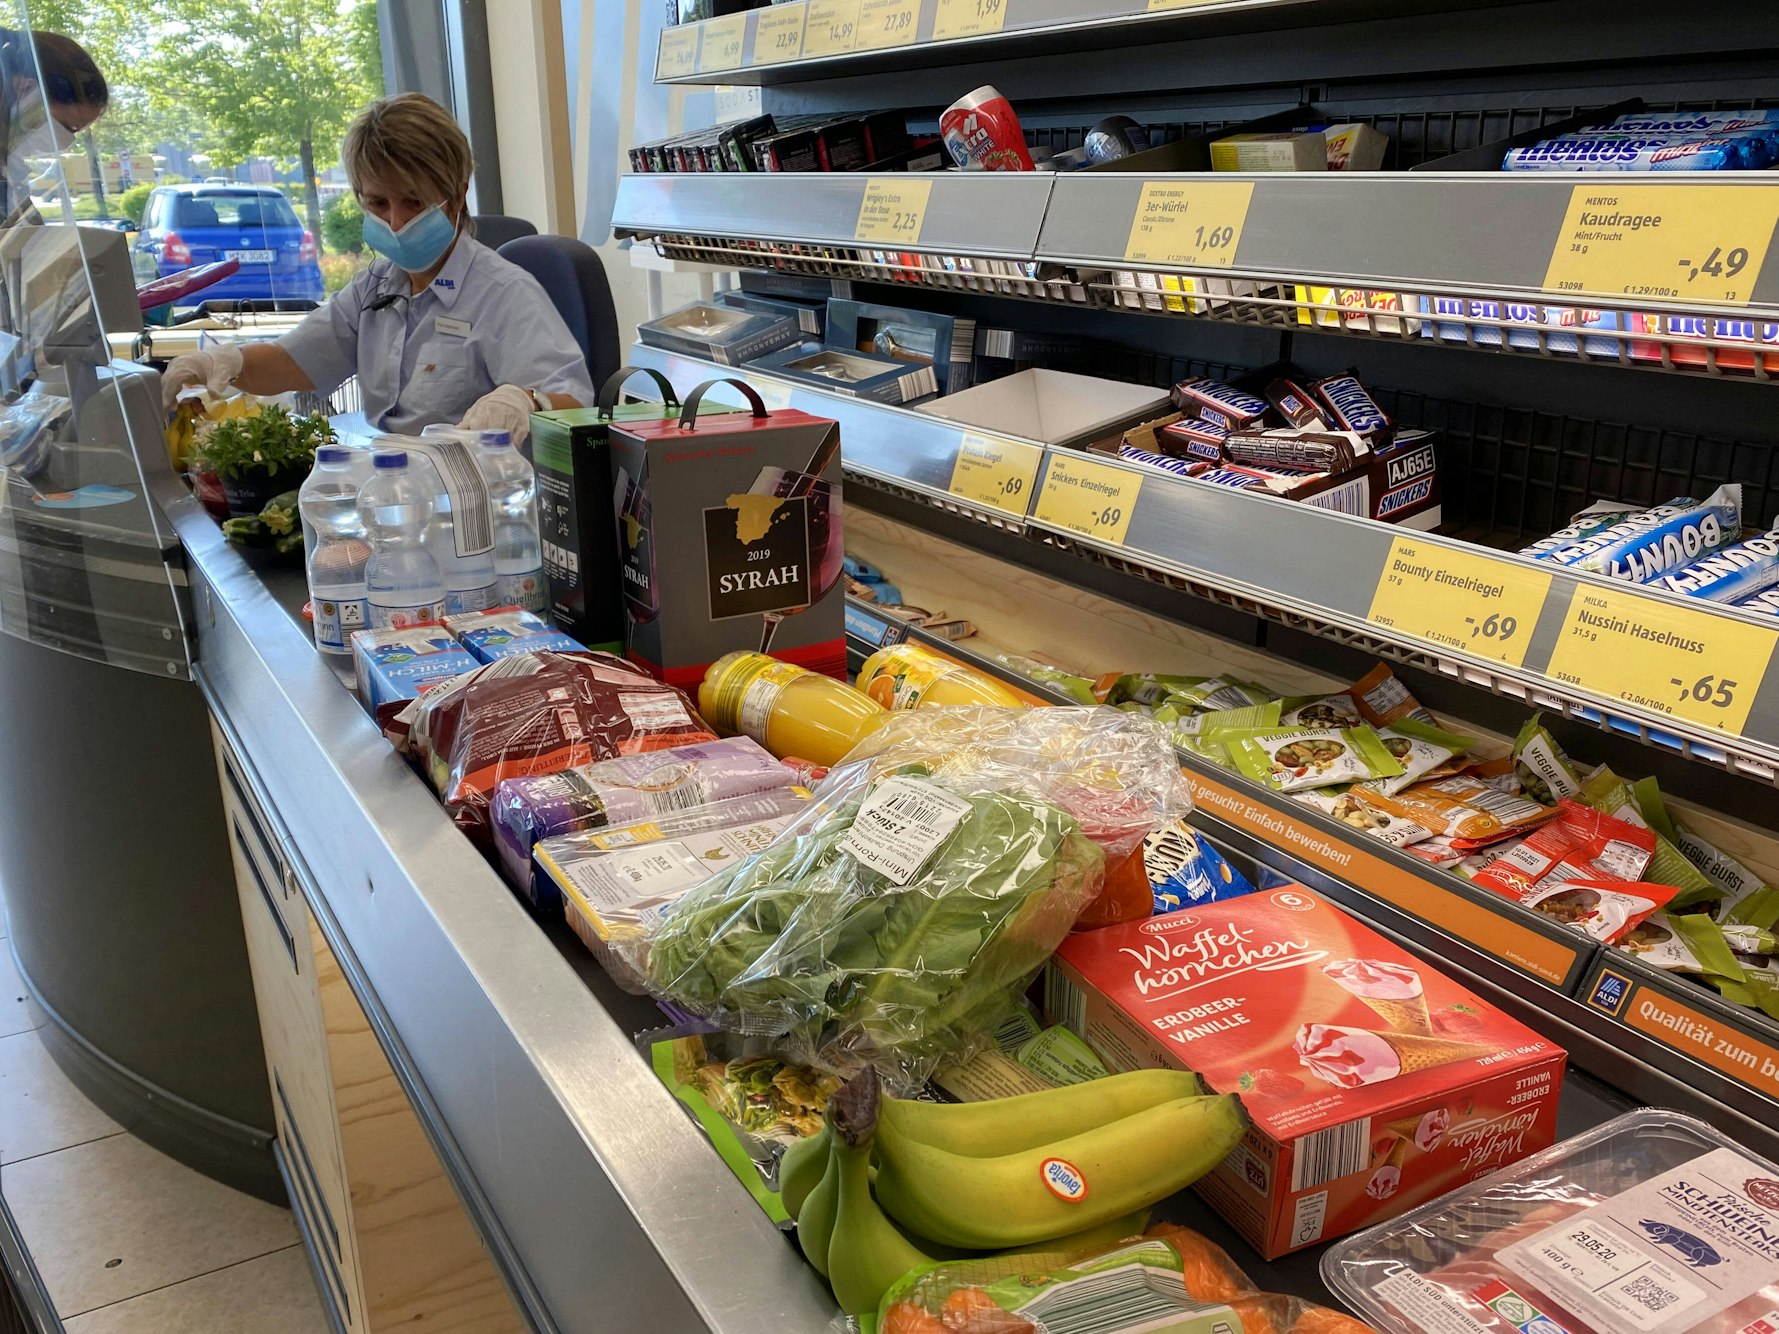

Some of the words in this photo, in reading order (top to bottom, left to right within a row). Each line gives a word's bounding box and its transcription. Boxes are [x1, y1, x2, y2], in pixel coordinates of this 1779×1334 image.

[884, 12, 912, 31] 27,89
[776, 32, 798, 49] 22,99
[830, 24, 852, 40] 14,99
[724, 42, 739, 58] 6,99
[972, 140, 996, 162] WHITE
[1514, 146, 1643, 164] mentos
[888, 194, 901, 203] Extra
[1145, 201, 1189, 212] 3er-Würfel
[1585, 197, 1618, 206] MENTOS
[869, 205, 878, 214] der
[892, 212, 917, 232] 2,25
[1579, 212, 1662, 230] Kaudragee
[1195, 225, 1234, 252] 1,69
[1574, 230, 1622, 242] Mint/Frucht
[1570, 243, 1581, 252] 38
[1582, 244, 1588, 254] g
[1678, 246, 1749, 282] -,49
[1557, 281, 1584, 290] 53098
[1623, 285, 1630, 294] €
[1724, 291, 1736, 300] 13
[1324, 377, 1388, 430] SNICKERS
[1201, 407, 1226, 427] SNICKERS
[983, 449, 1003, 463] Riegel
[1189, 441, 1220, 459] SNICKERS
[1392, 449, 1432, 483] AJ65E
[997, 478, 1022, 496] -,69
[1051, 470, 1078, 486] Snickers
[1080, 478, 1120, 497] Einzelriegel
[1379, 479, 1431, 516] SNICKERS
[1091, 506, 1121, 526] -,69
[747, 548, 771, 562] 2019
[1397, 547, 1416, 558] MARS
[1610, 512, 1720, 583] BOUNTY
[624, 564, 649, 590] SYRAH
[719, 564, 799, 595] SYRAH
[1392, 560, 1434, 582] Bounty
[1434, 570, 1504, 598] Einzelriegel
[1583, 596, 1608, 609] MILKA
[1374, 614, 1394, 627] 52952
[1464, 613, 1517, 641] -,69
[1431, 632, 1460, 647] 1,21/100
[1572, 627, 1591, 639] 31,5
[1590, 631, 1597, 642] g
[1578, 609, 1630, 634] Nussini
[1630, 623, 1705, 654] Haselnuss
[388, 658, 470, 678] H-MILCH
[1556, 671, 1581, 685] 53638
[1670, 674, 1738, 708] -,65
[1620, 691, 1627, 699] €
[1627, 692, 1665, 712] 2,06/100
[1717, 720, 1724, 729] 4
[1262, 731, 1297, 743] VEGGIE
[1530, 746, 1558, 781] VEGGIE
[864, 807, 897, 831] Stück
[1198, 784, 1245, 814] gesucht?
[1244, 806, 1284, 836] Einfach
[1285, 825, 1352, 866] bewerben!
[894, 824, 907, 836] 2
[915, 822, 940, 838] L2007
[842, 835, 909, 880] Mini-Roma
[1514, 847, 1540, 864] 10.01.2021
[1678, 837, 1713, 870] VEGGIE
[1710, 863, 1745, 892] BURST
[1279, 894, 1302, 905] 6
[1145, 916, 1194, 933] Mucci
[1118, 922, 1254, 970] Waffel-
[1133, 939, 1309, 995] hörnchen
[1505, 950, 1561, 981] karriere.aldi-sued.de
[1596, 990, 1618, 1006] ALDI
[1151, 996, 1247, 1030] ERDBEER-
[1168, 1012, 1251, 1044] VANILLE
[1640, 1000, 1715, 1047] Qualität
[1713, 1039, 1758, 1069] zum
[1476, 1057, 1494, 1066] 720
[1515, 1071, 1551, 1091] VANILLE
[1506, 1084, 1551, 1106] ERDBEER-
[1300, 1109, 1312, 1117] und
[1448, 1107, 1539, 1148] hörnchen
[1248, 1135, 1263, 1152] 120
[1460, 1130, 1524, 1170] Waffel-
[1049, 1163, 1081, 1195] favorita
[1249, 1171, 1265, 1187] UTZ
[1717, 1194, 1771, 1226] Frische
[1678, 1214, 1692, 1224] oder
[1704, 1229, 1716, 1238] den
[1718, 1237, 1732, 1248] Grill
[1712, 1224, 1727, 1234] dem
[1571, 1230, 1616, 1261] 29.05.20
[1714, 1230, 1731, 1243] zum
[1732, 1241, 1754, 1256] Braten
[1542, 1248, 1563, 1263] 400
[1562, 1261, 1572, 1270] g
[1404, 1272, 1423, 1288] ALDI
[1424, 1286, 1442, 1301] SÜD
[1441, 1300, 1484, 1334] unterstützt
